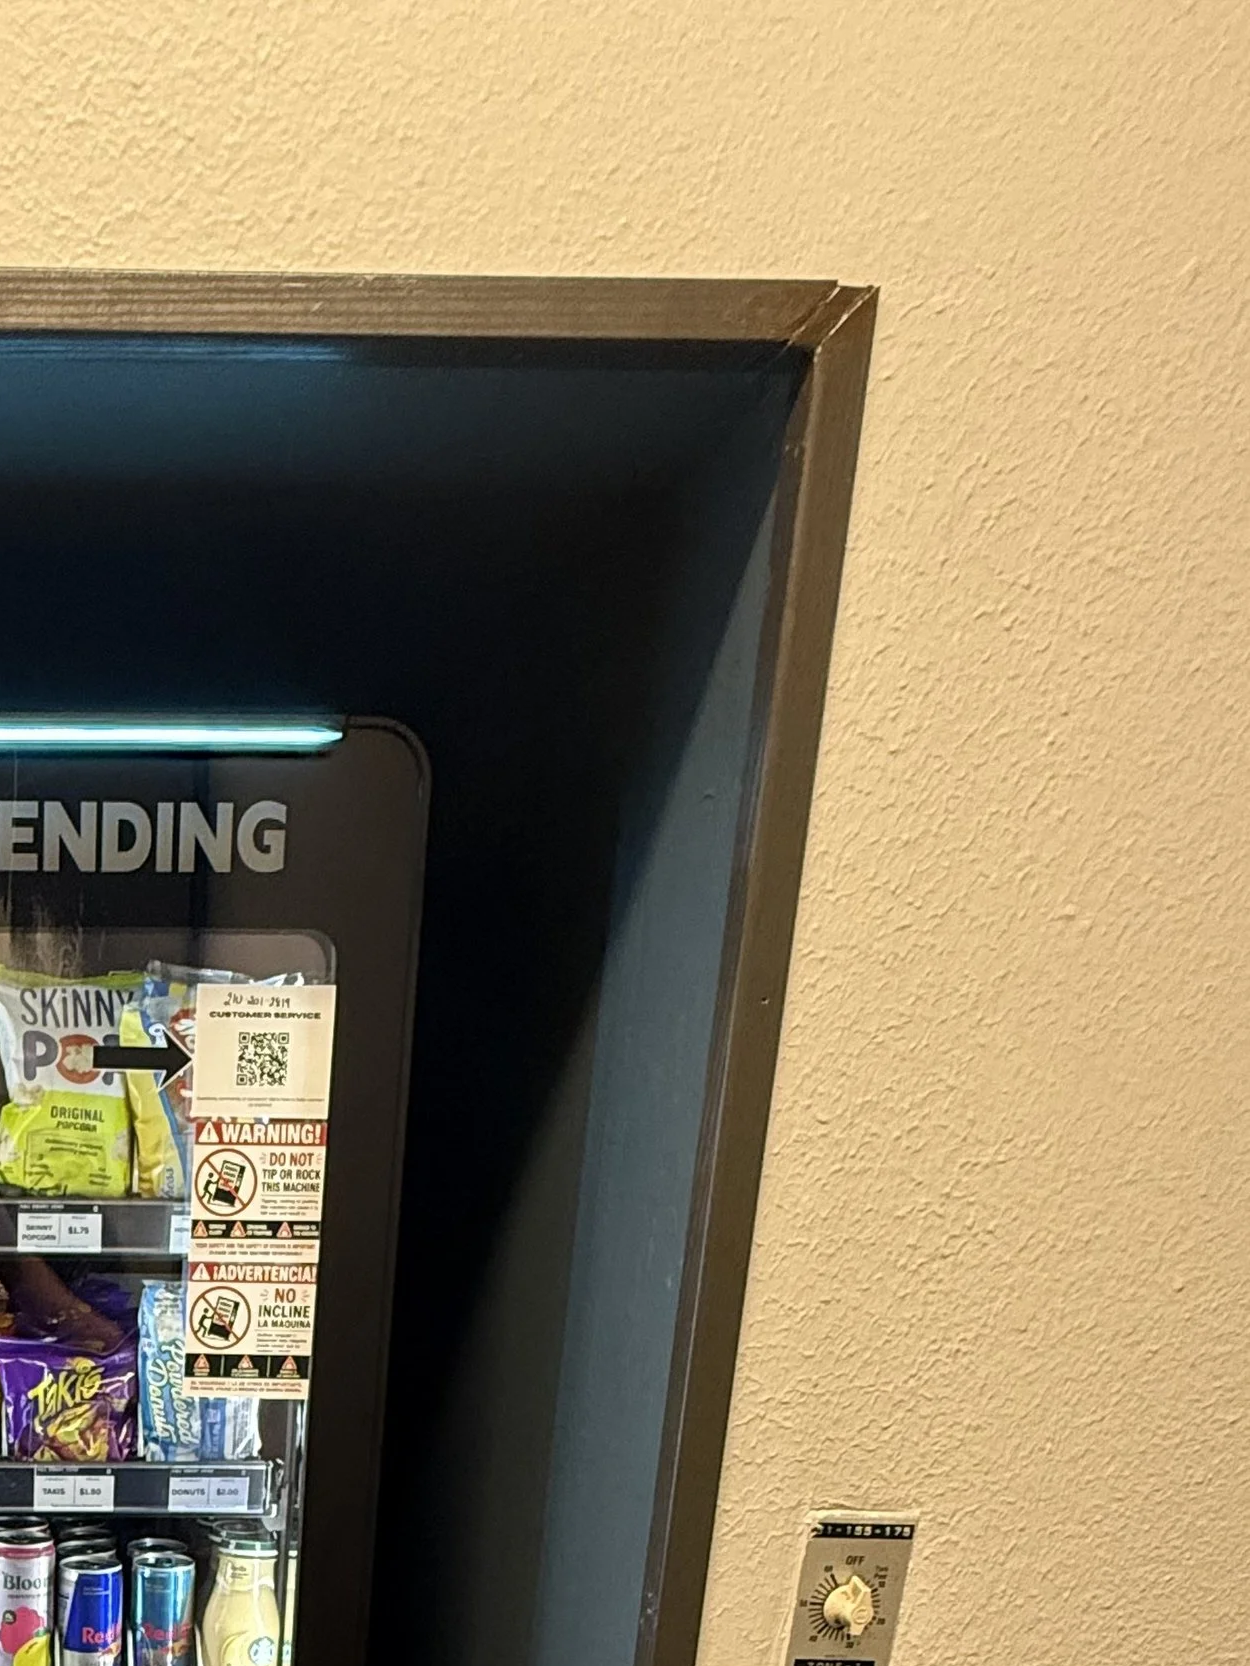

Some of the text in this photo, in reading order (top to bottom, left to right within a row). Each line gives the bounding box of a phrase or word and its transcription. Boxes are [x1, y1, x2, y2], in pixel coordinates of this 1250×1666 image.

[209, 1011, 322, 1020] CUSTOMER SERVICE
[50, 1105, 105, 1123] ORIGINAL
[55, 1120, 98, 1132] POPCORN
[221, 1123, 322, 1145] WARNING!
[269, 1152, 315, 1167] DO NOT
[262, 1169, 321, 1181] TIP OR ROCK
[261, 1181, 320, 1194] THIS MACHINE
[212, 1265, 317, 1282] ¡ADVERTENCIA!
[274, 1288, 296, 1304] NO
[258, 1305, 311, 1318] INCLINE
[257, 1320, 268, 1329] LA
[148, 1356, 177, 1446] Donuts
[42, 1487, 66, 1496] TAKIS
[171, 1488, 206, 1497] DONUTS
[845, 1556, 865, 1566] OFF
